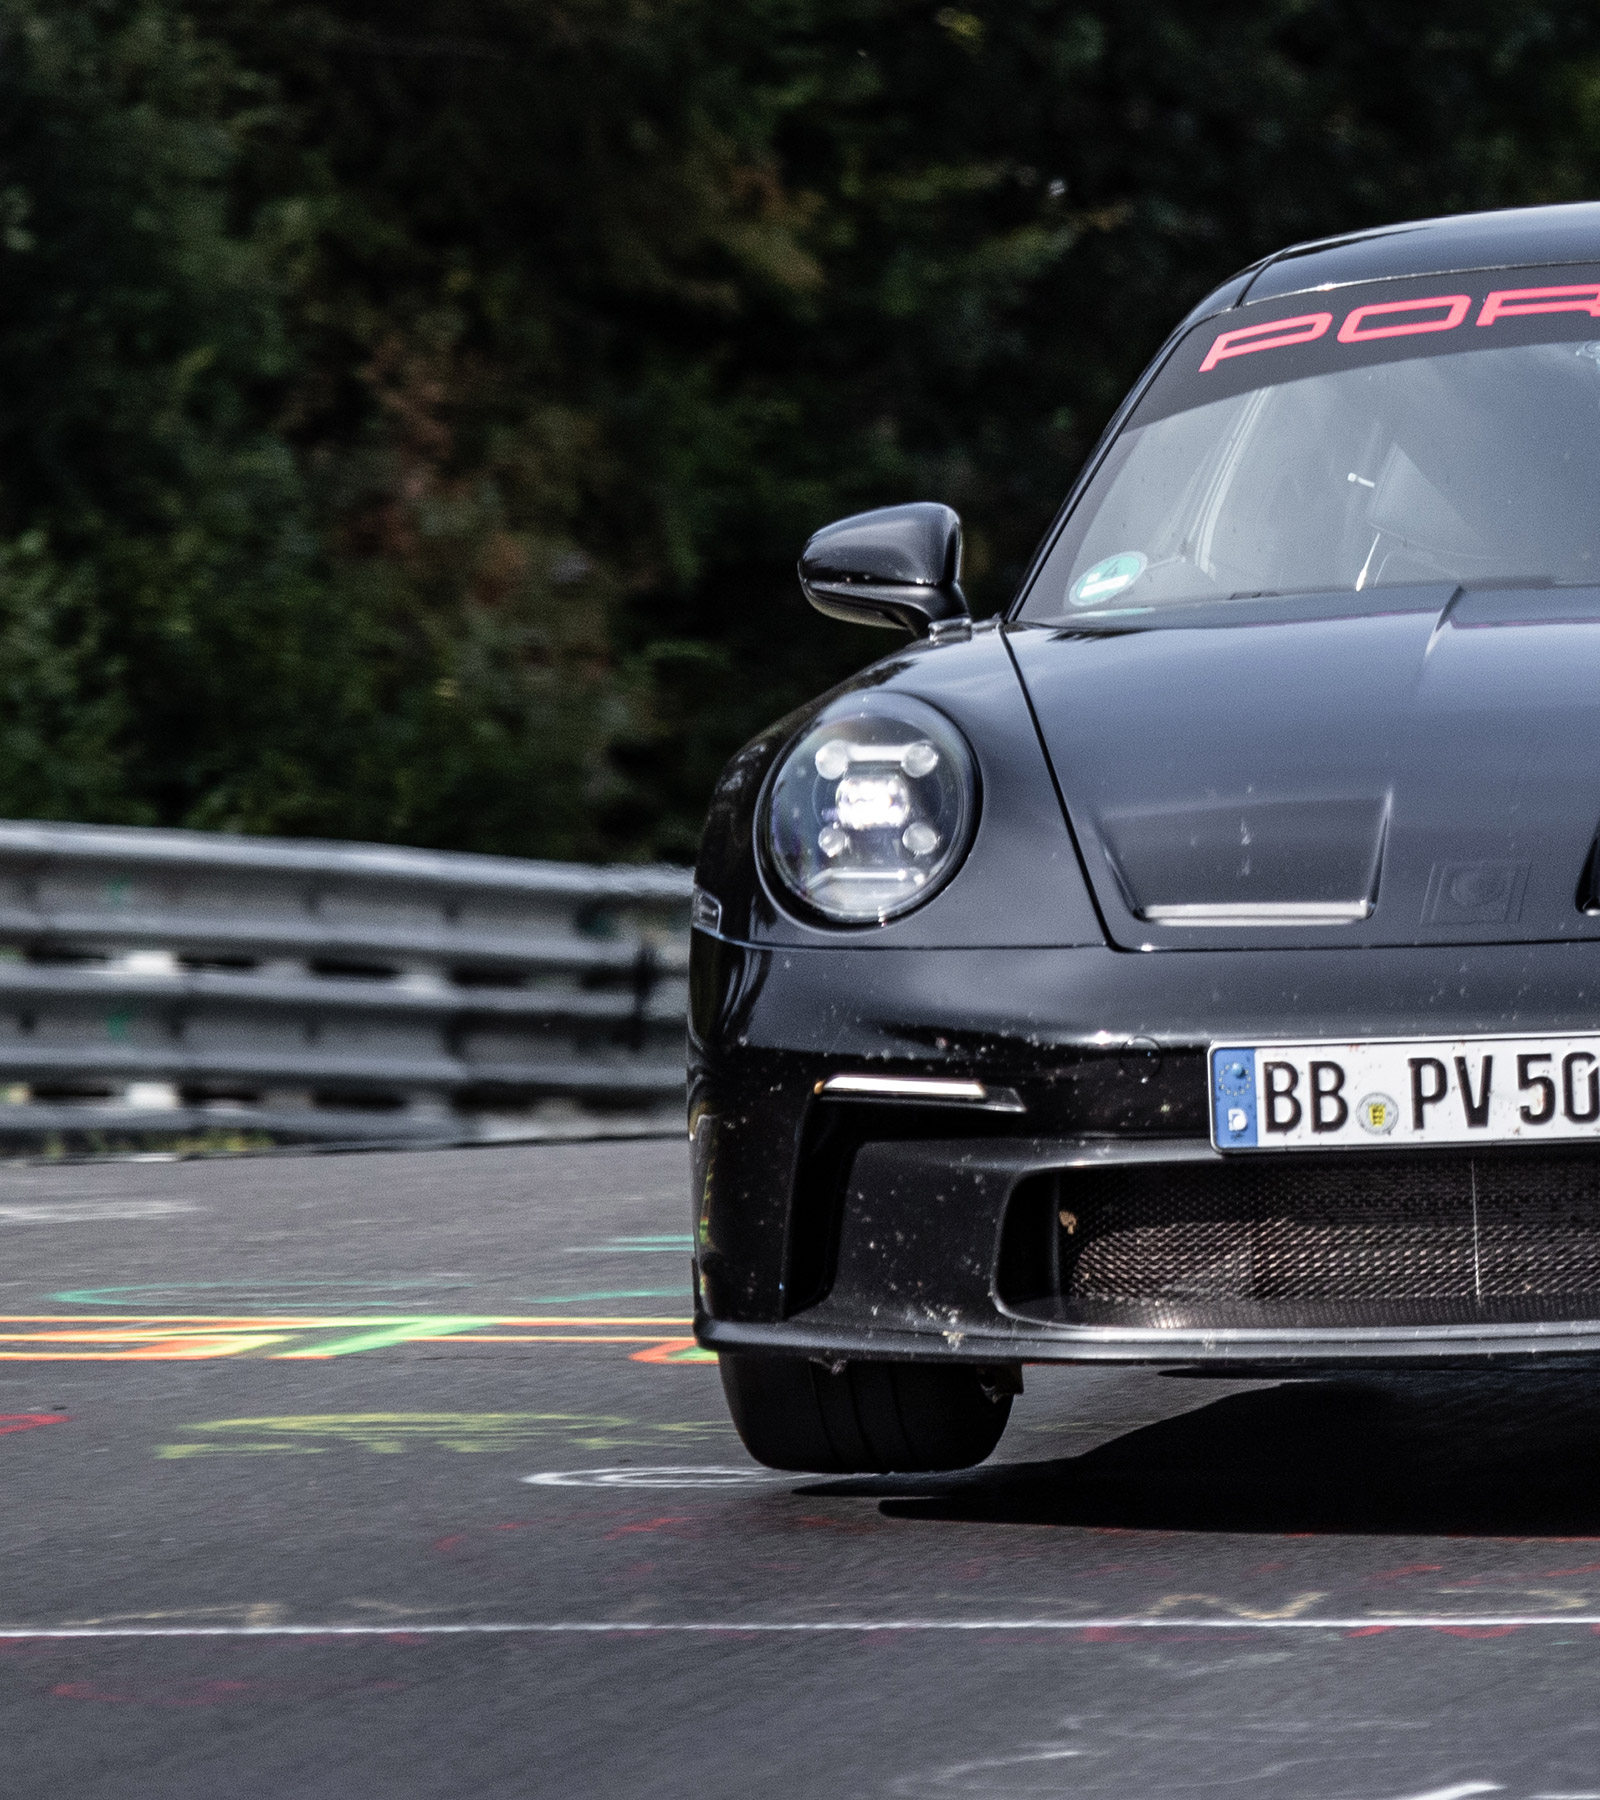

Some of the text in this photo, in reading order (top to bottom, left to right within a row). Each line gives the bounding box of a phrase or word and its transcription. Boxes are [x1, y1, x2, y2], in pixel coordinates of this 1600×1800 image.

[1264, 1061, 1349, 1133] BB
[1409, 1055, 1493, 1129] PV
[1228, 1108, 1247, 1131] D
